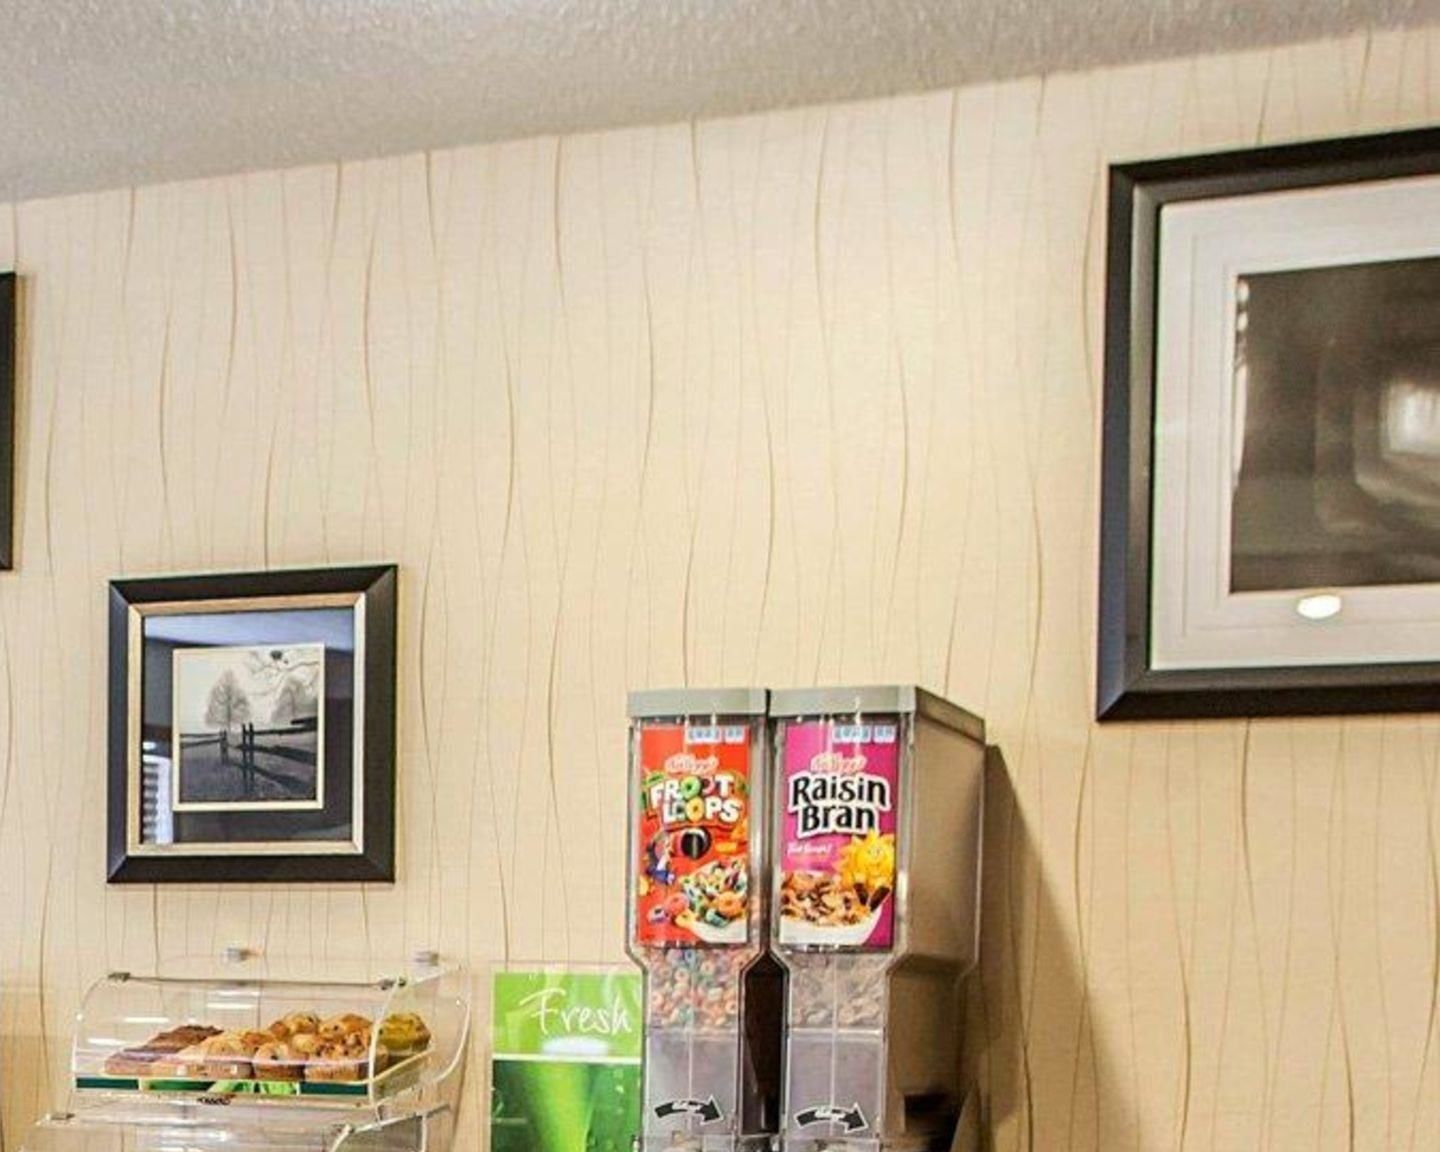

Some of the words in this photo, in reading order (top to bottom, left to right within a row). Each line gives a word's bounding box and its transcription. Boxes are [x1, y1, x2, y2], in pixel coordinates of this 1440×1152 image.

[792, 775, 887, 808] Raisin
[663, 796, 742, 824] LOOPS
[801, 804, 875, 834] Bran
[519, 987, 633, 1036] Fresh
